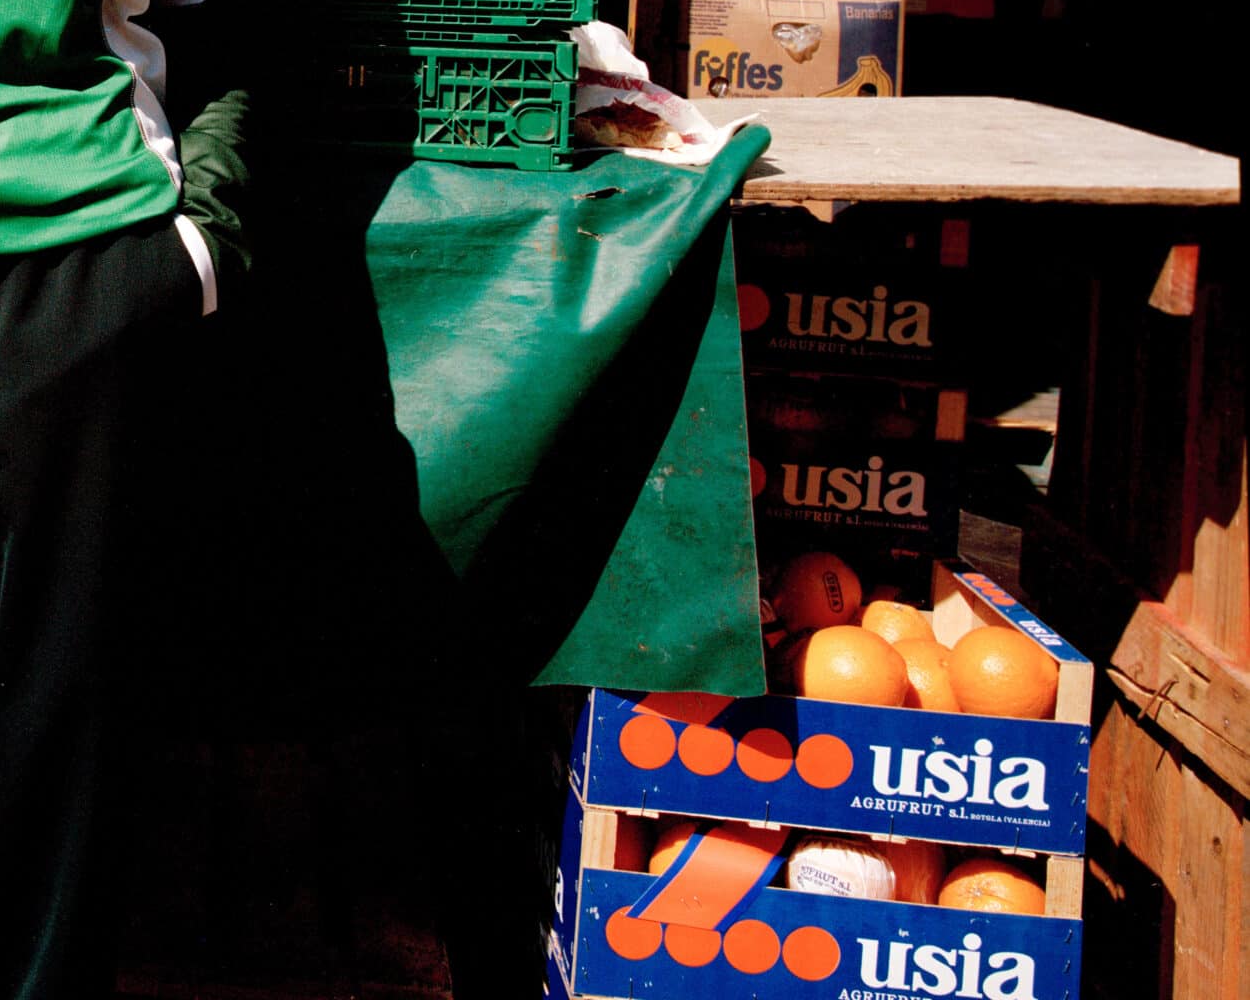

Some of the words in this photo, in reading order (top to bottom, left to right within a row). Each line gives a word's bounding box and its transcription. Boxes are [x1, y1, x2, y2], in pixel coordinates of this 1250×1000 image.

[845, 5, 894, 21] Bananas
[783, 283, 935, 348] usia
[781, 455, 928, 518] usia
[869, 738, 1050, 811] usia
[851, 796, 945, 817] AGRUFRUT
[838, 988, 932, 1000] AGRUF
[856, 932, 1038, 1000] usia
